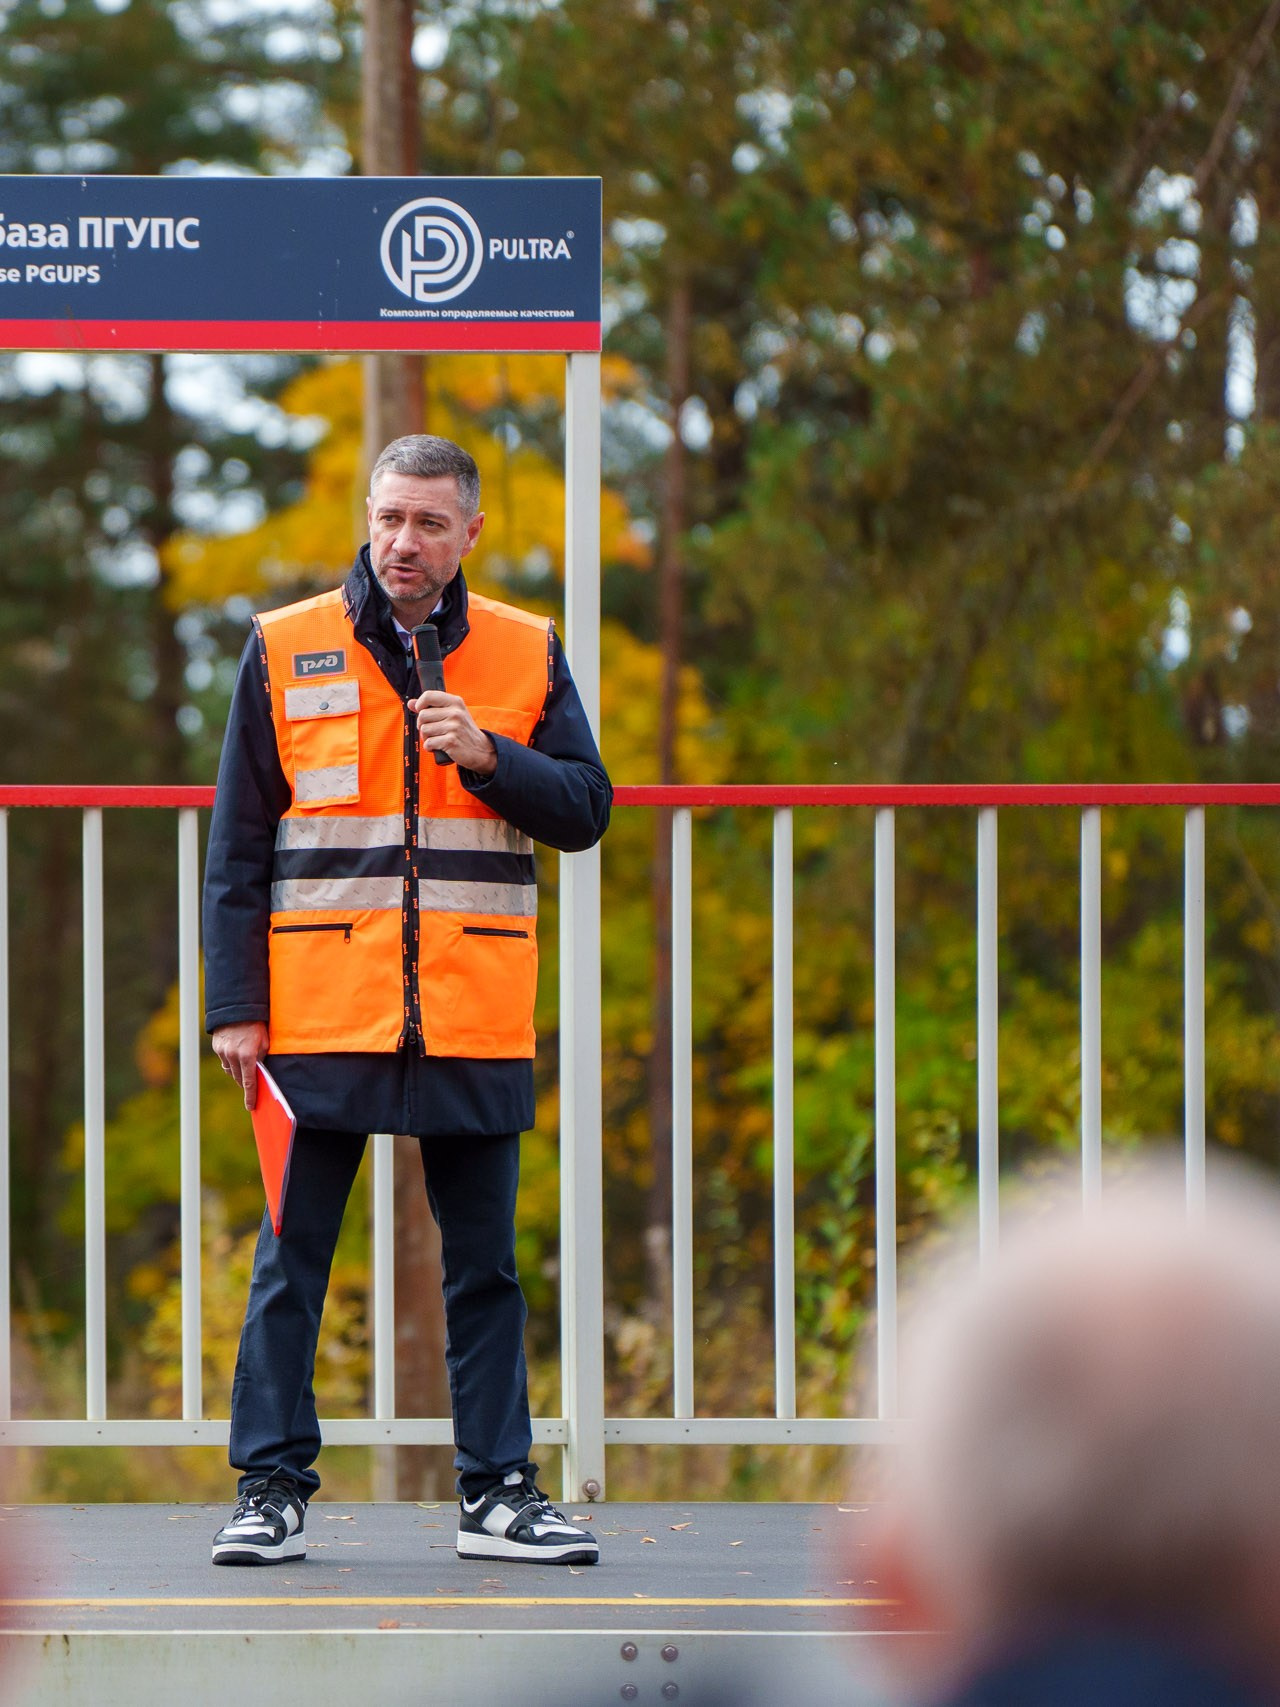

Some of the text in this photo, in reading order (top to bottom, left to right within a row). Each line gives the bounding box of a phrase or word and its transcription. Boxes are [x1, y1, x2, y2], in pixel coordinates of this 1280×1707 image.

[78, 217, 200, 249] ПГУПС
[25, 264, 101, 284] PGUPS
[379, 308, 575, 320] Композиты определяемые качеством
